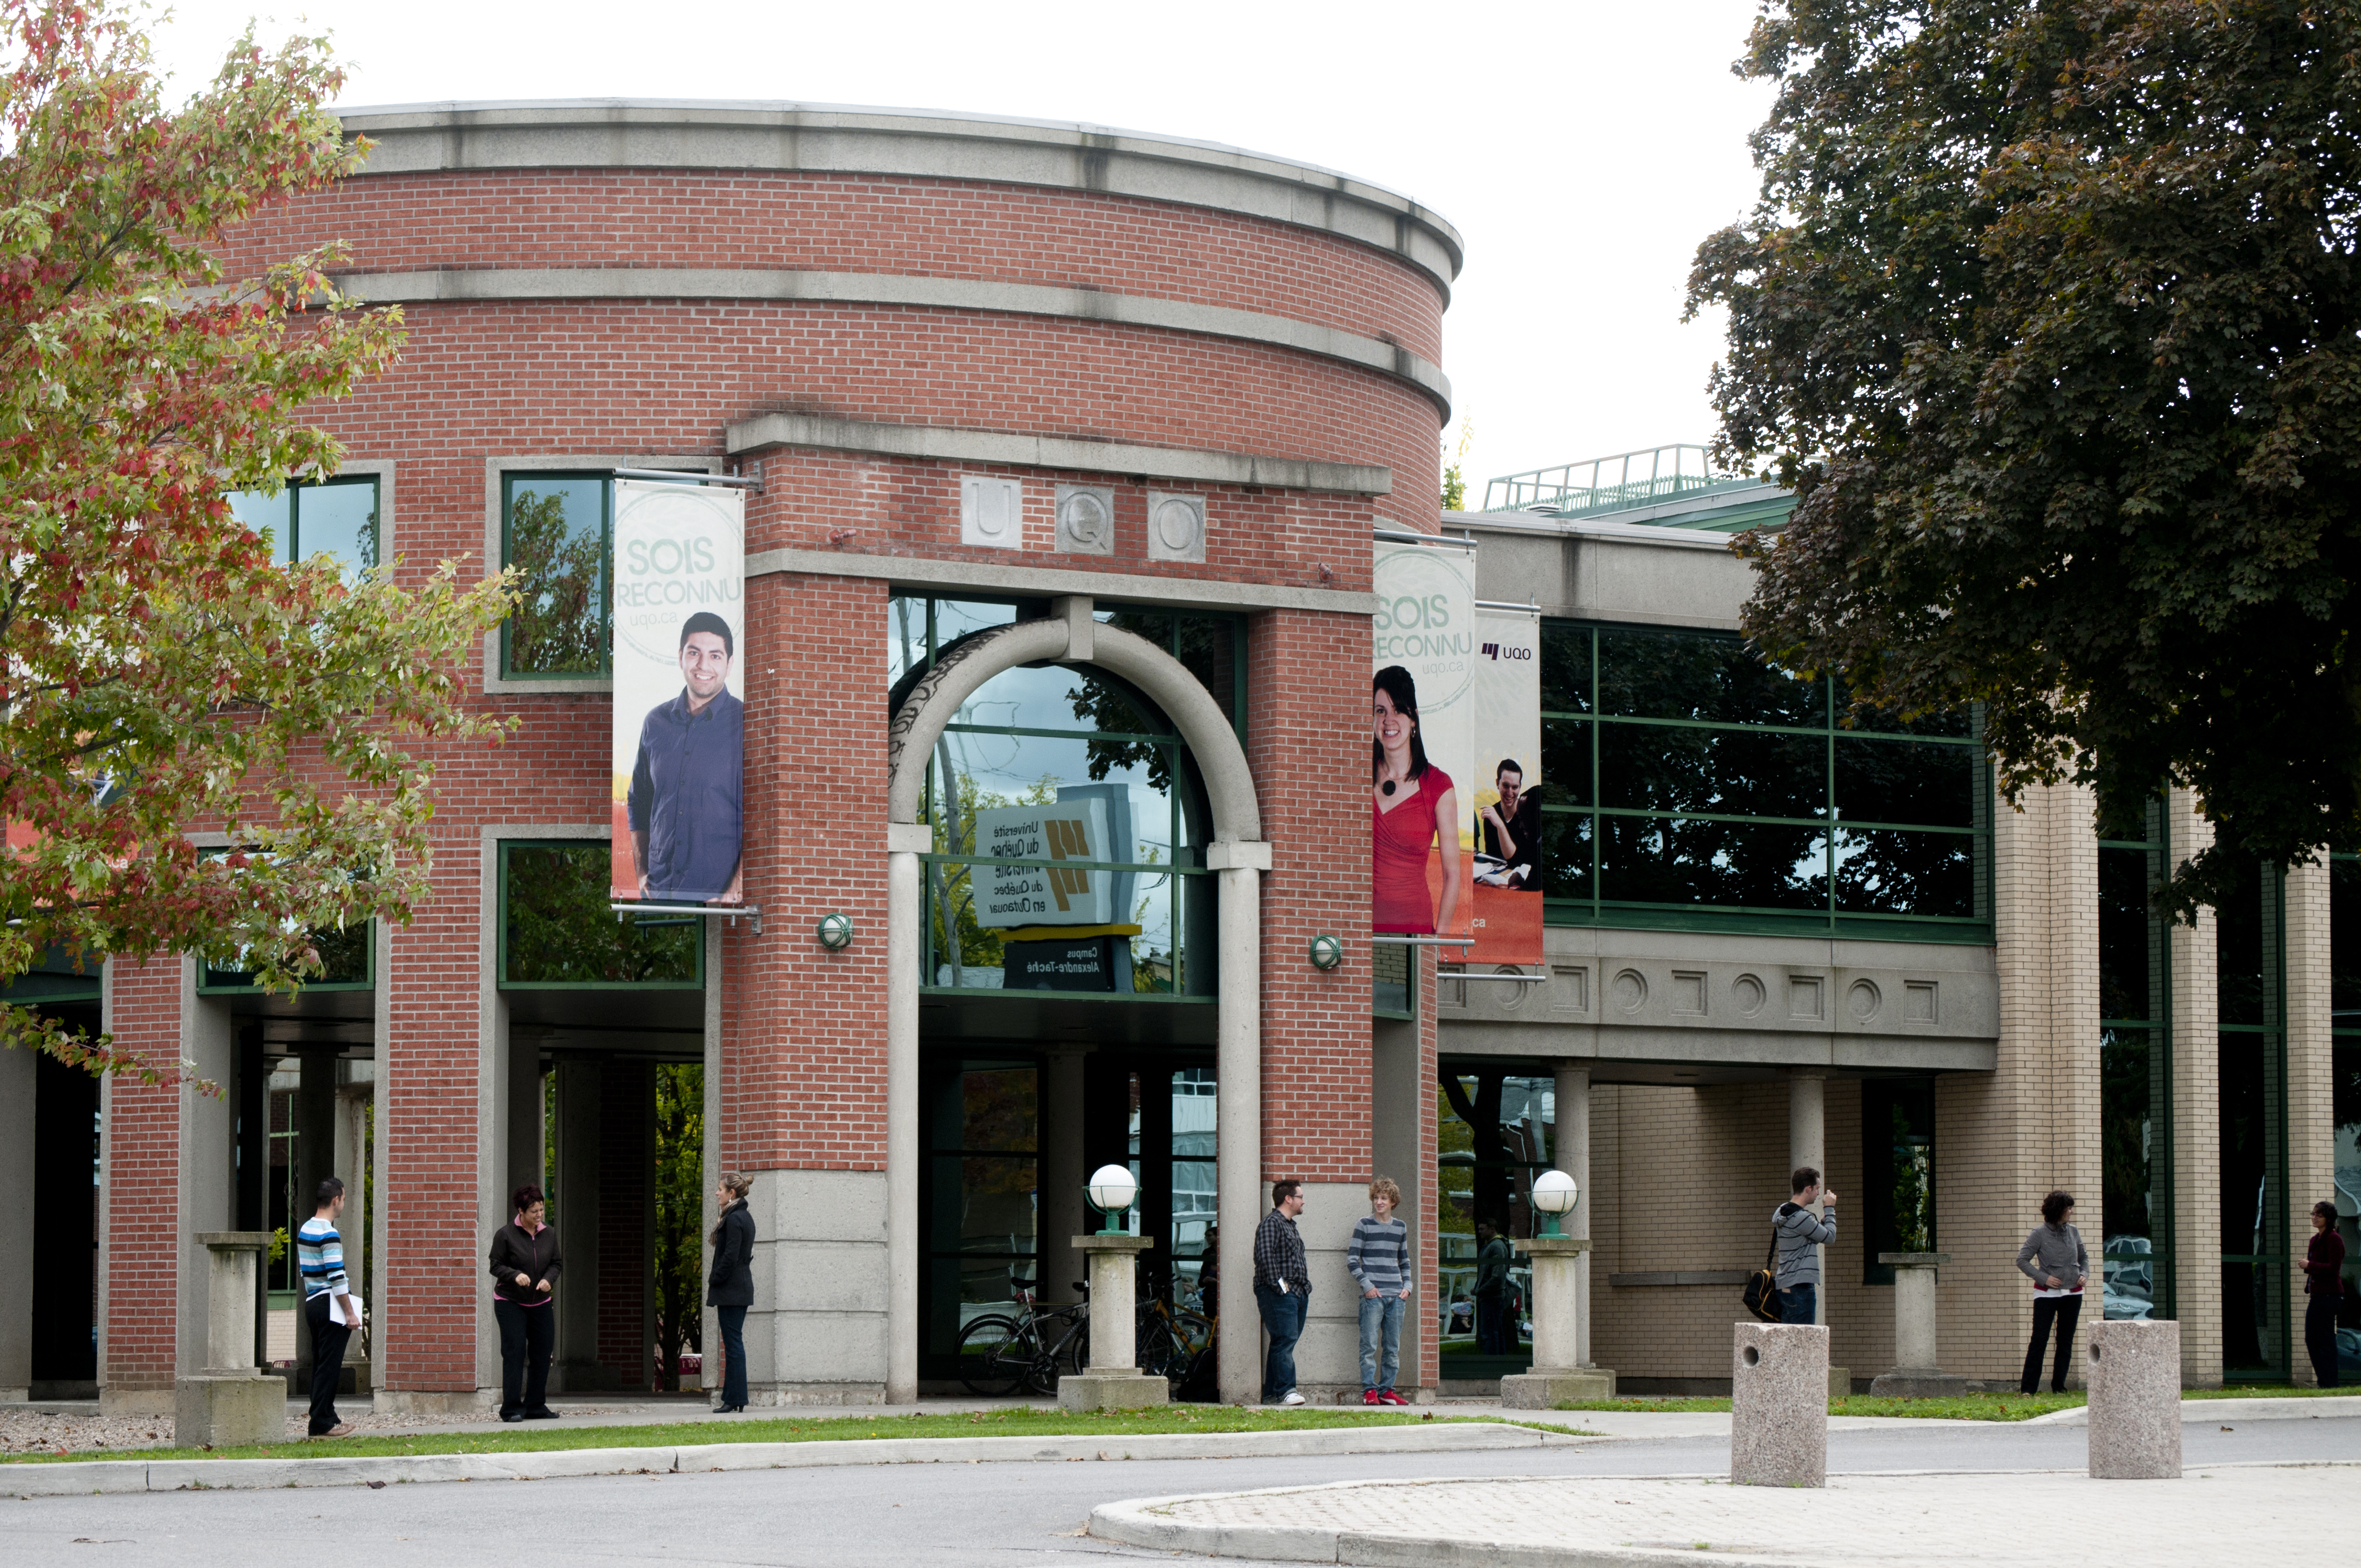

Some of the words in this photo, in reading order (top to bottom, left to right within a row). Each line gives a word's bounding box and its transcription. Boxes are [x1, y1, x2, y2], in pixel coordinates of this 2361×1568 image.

[627, 536, 715, 576] SOIS
[616, 576, 741, 607] RECONNU
[629, 612, 678, 630] uqo.ca
[1373, 594, 1450, 630] SOIS
[1373, 631, 1473, 660] ECONNU
[1503, 646, 1531, 660] UQO
[1422, 661, 1465, 678] uqo.ca
